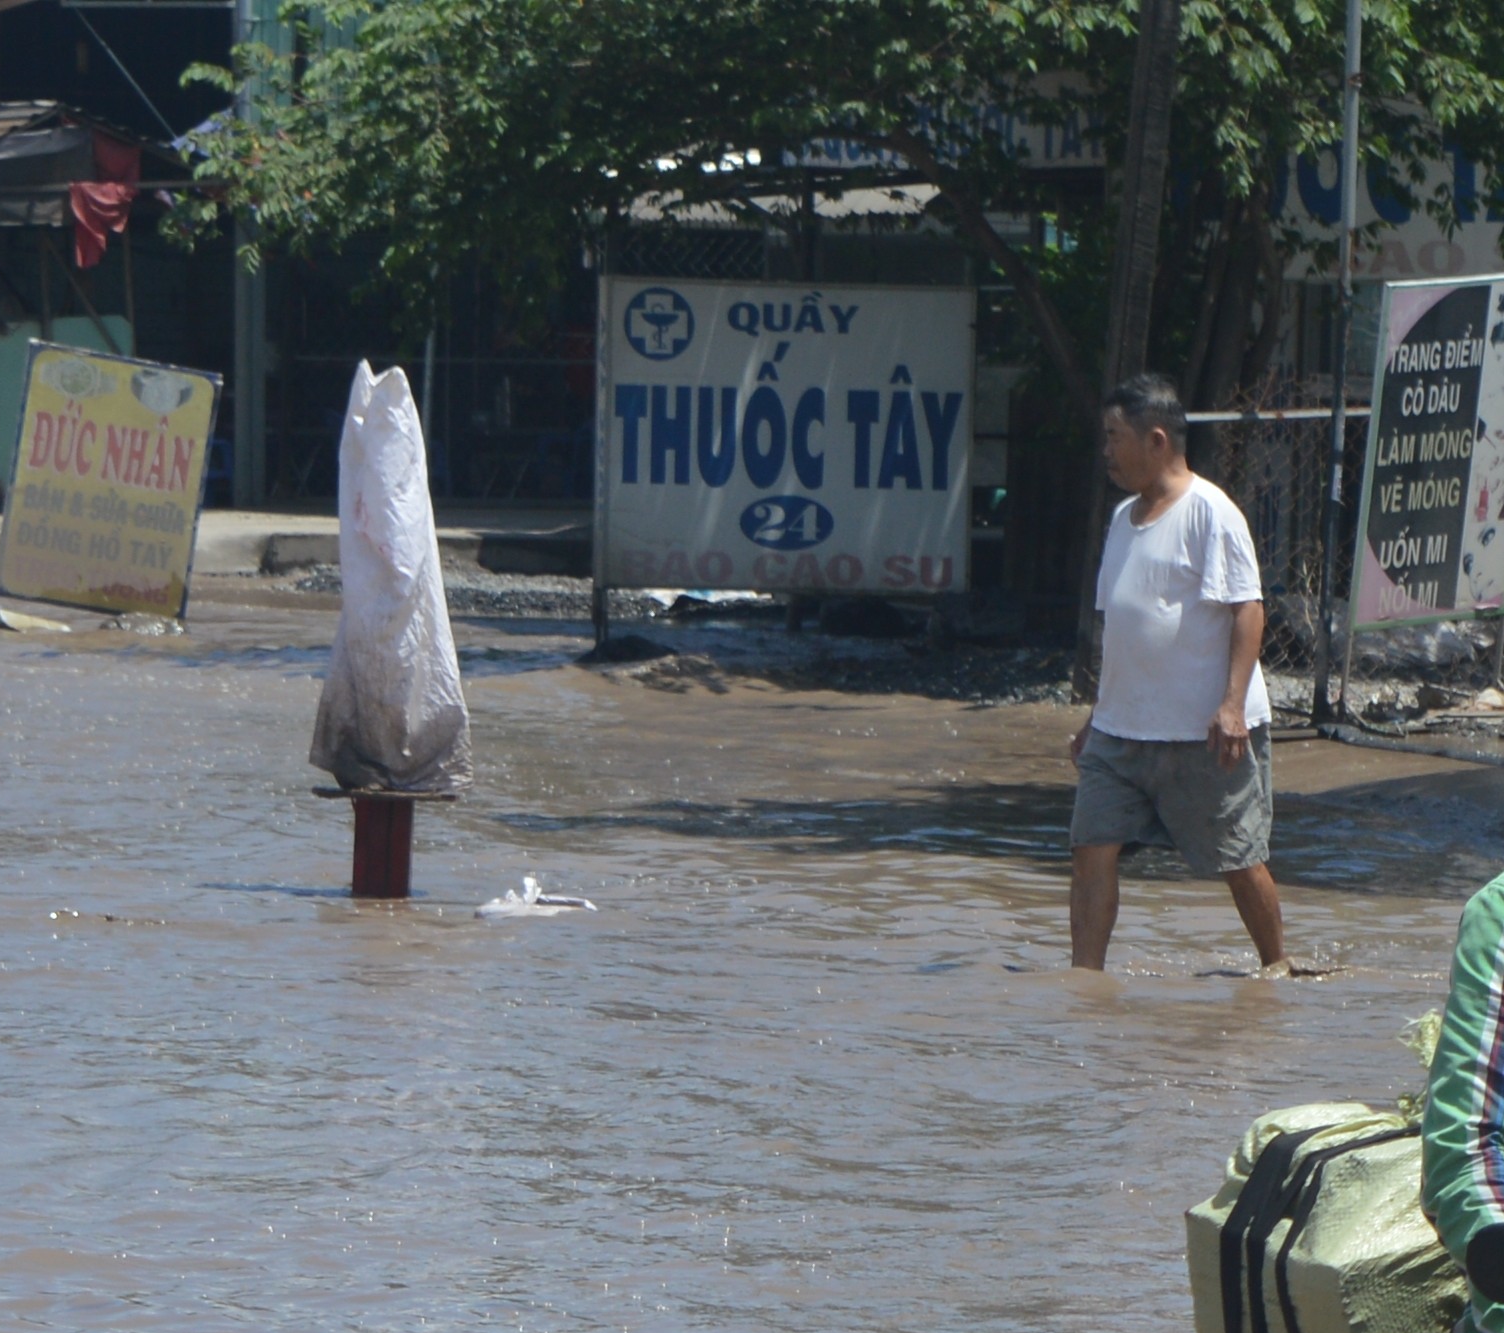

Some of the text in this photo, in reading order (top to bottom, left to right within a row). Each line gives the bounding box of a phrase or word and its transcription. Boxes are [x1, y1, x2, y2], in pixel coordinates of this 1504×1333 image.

[727, 290, 860, 337] QUẦY
[1388, 323, 1485, 376] TRANG ĐIỂM
[614, 341, 964, 492] THUỐC TÂY
[1401, 375, 1462, 417] CÔ DÂU
[28, 399, 195, 492] ĐỨC NHÂN
[1376, 423, 1473, 468] LÀM MÓNG
[1380, 472, 1462, 515] VẼ MÓNG
[752, 503, 821, 542] 24
[1379, 522, 1449, 570] UỐN MI
[752, 552, 864, 588] CAO
[882, 554, 953, 589] SU
[1377, 571, 1439, 614] NỐI MI
